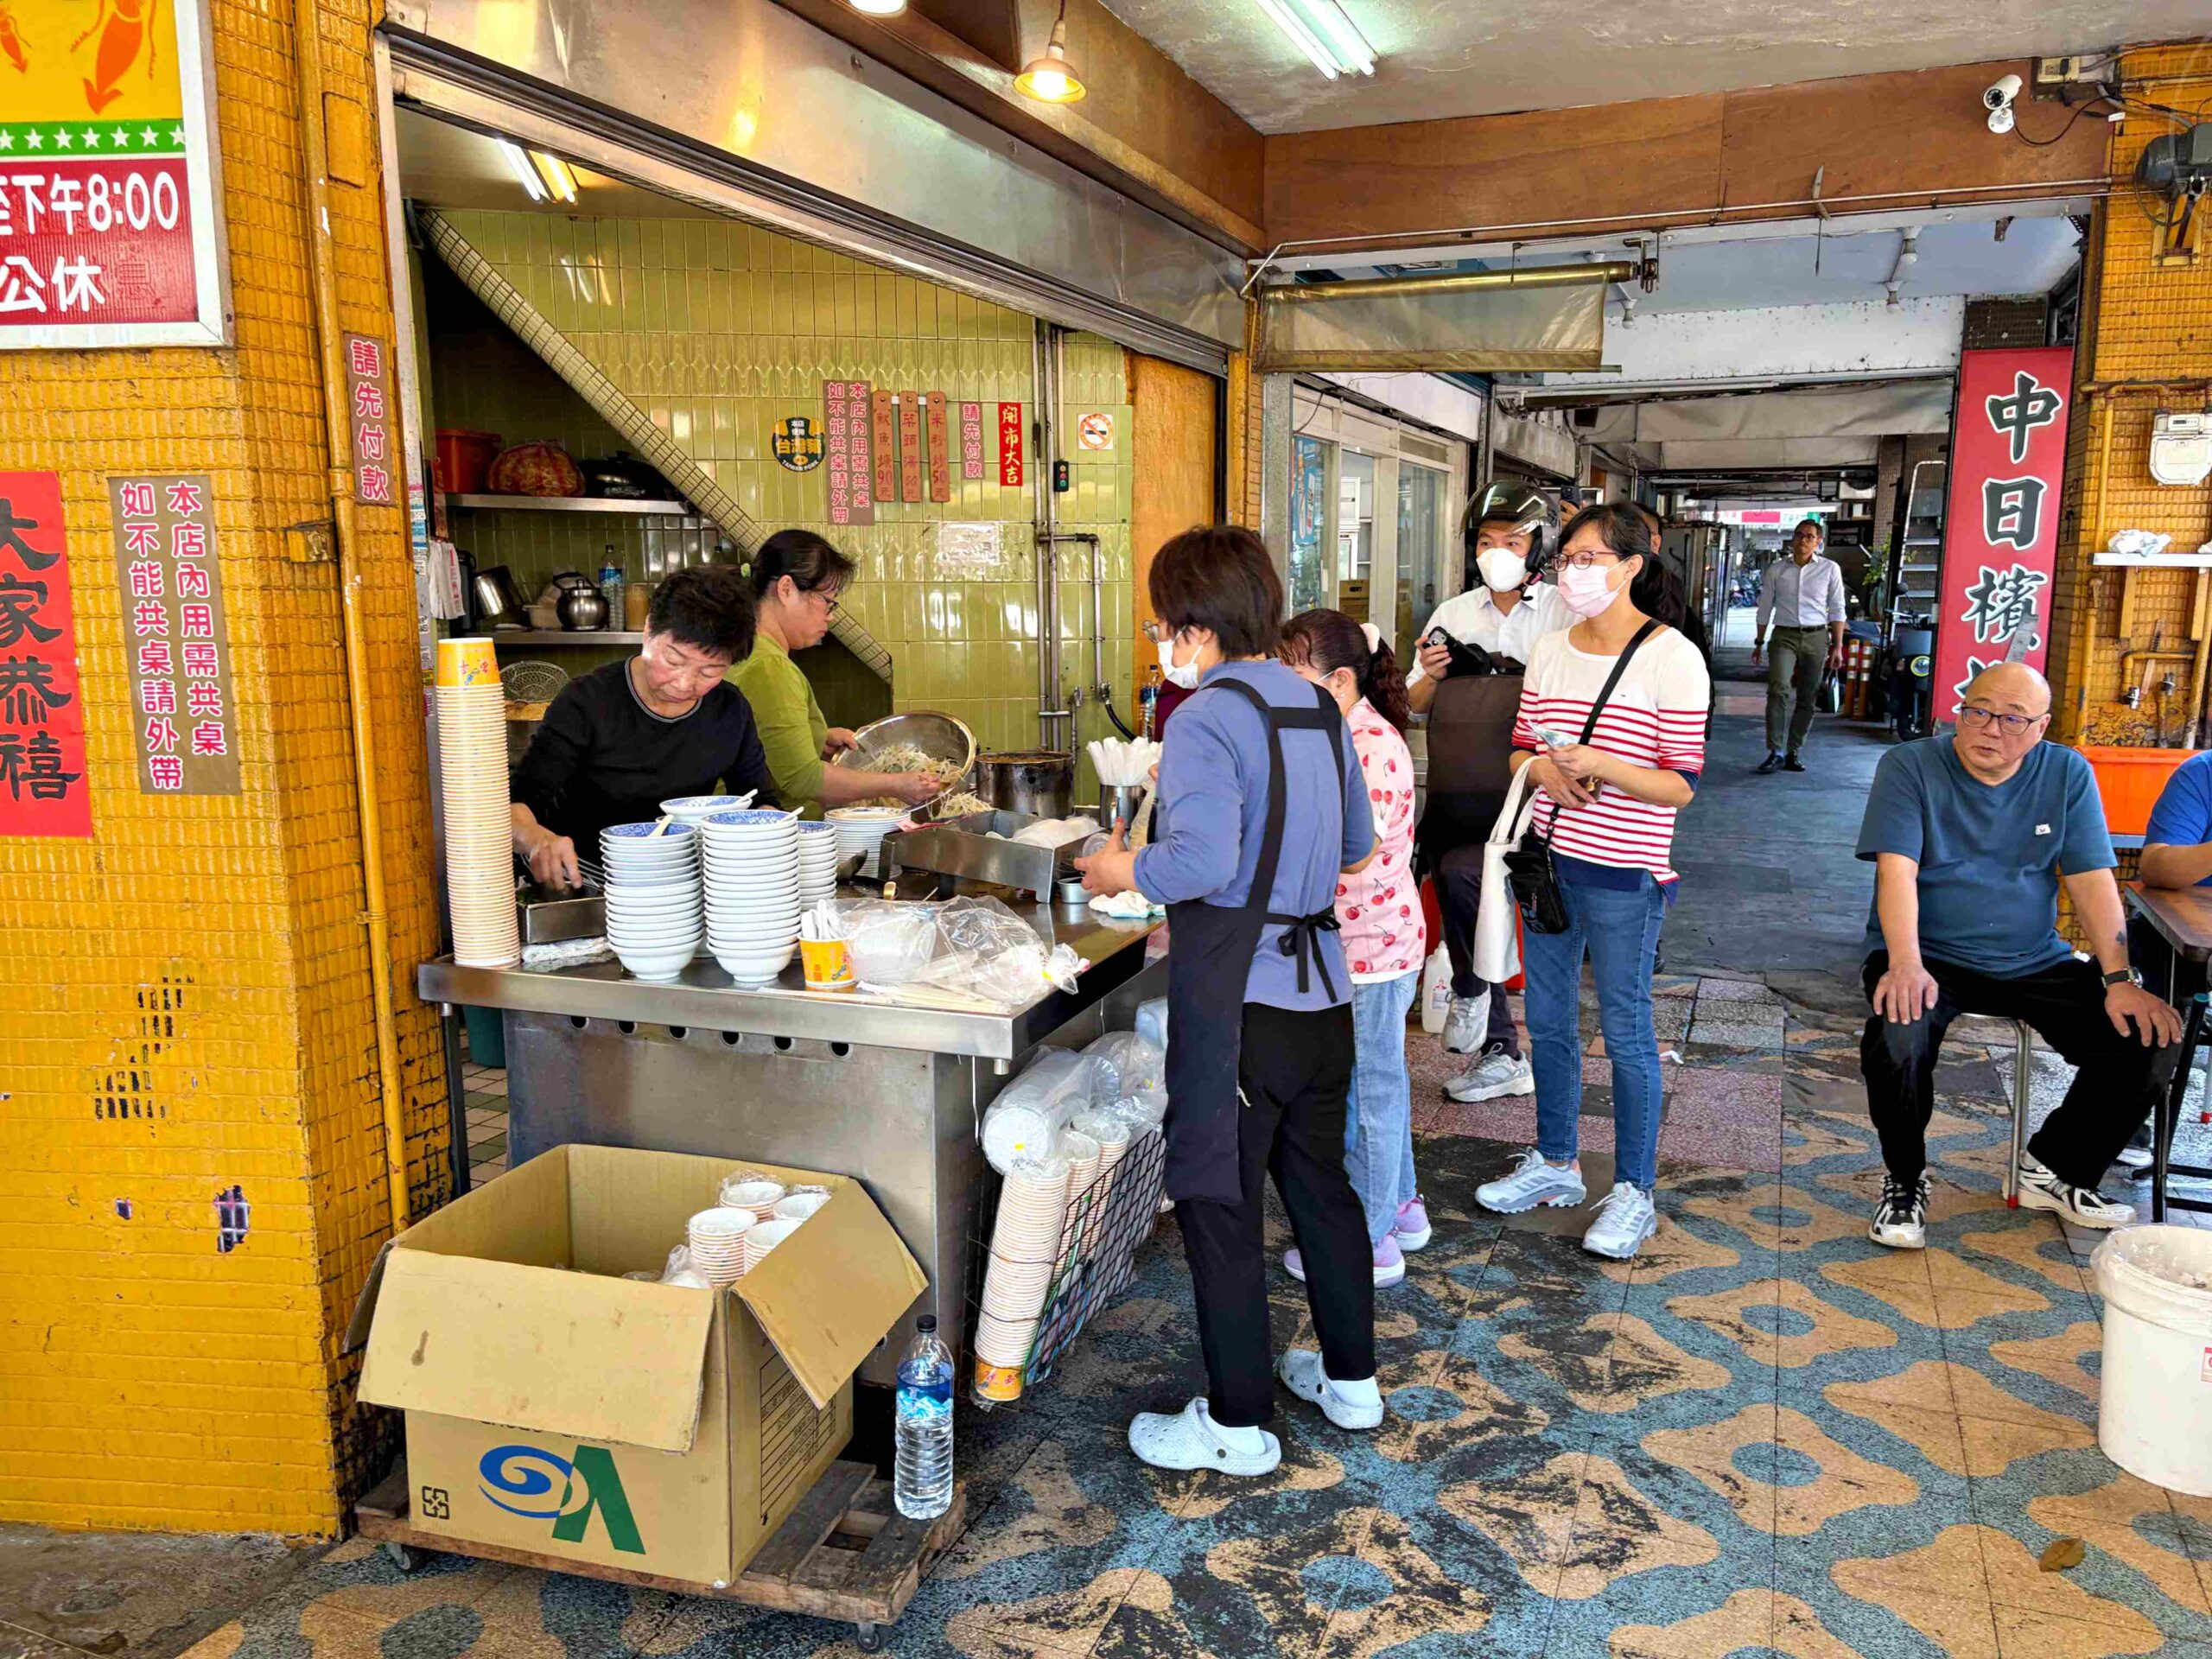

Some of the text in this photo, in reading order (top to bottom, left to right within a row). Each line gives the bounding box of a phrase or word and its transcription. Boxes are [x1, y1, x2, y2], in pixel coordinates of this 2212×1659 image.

[0, 256, 106, 312] 公休
[350, 340, 390, 501] 請先付款
[828, 383, 849, 523] 如不能共桌請外帶
[849, 383, 870, 508] 本店內用需共桌
[962, 403, 983, 478] 請先付款
[1001, 404, 1020, 484] 開市大吉
[1953, 371, 2063, 715] 中日檳
[120, 481, 184, 790] 如不能共桌請外帶
[166, 480, 228, 756] 本店內用需共桌
